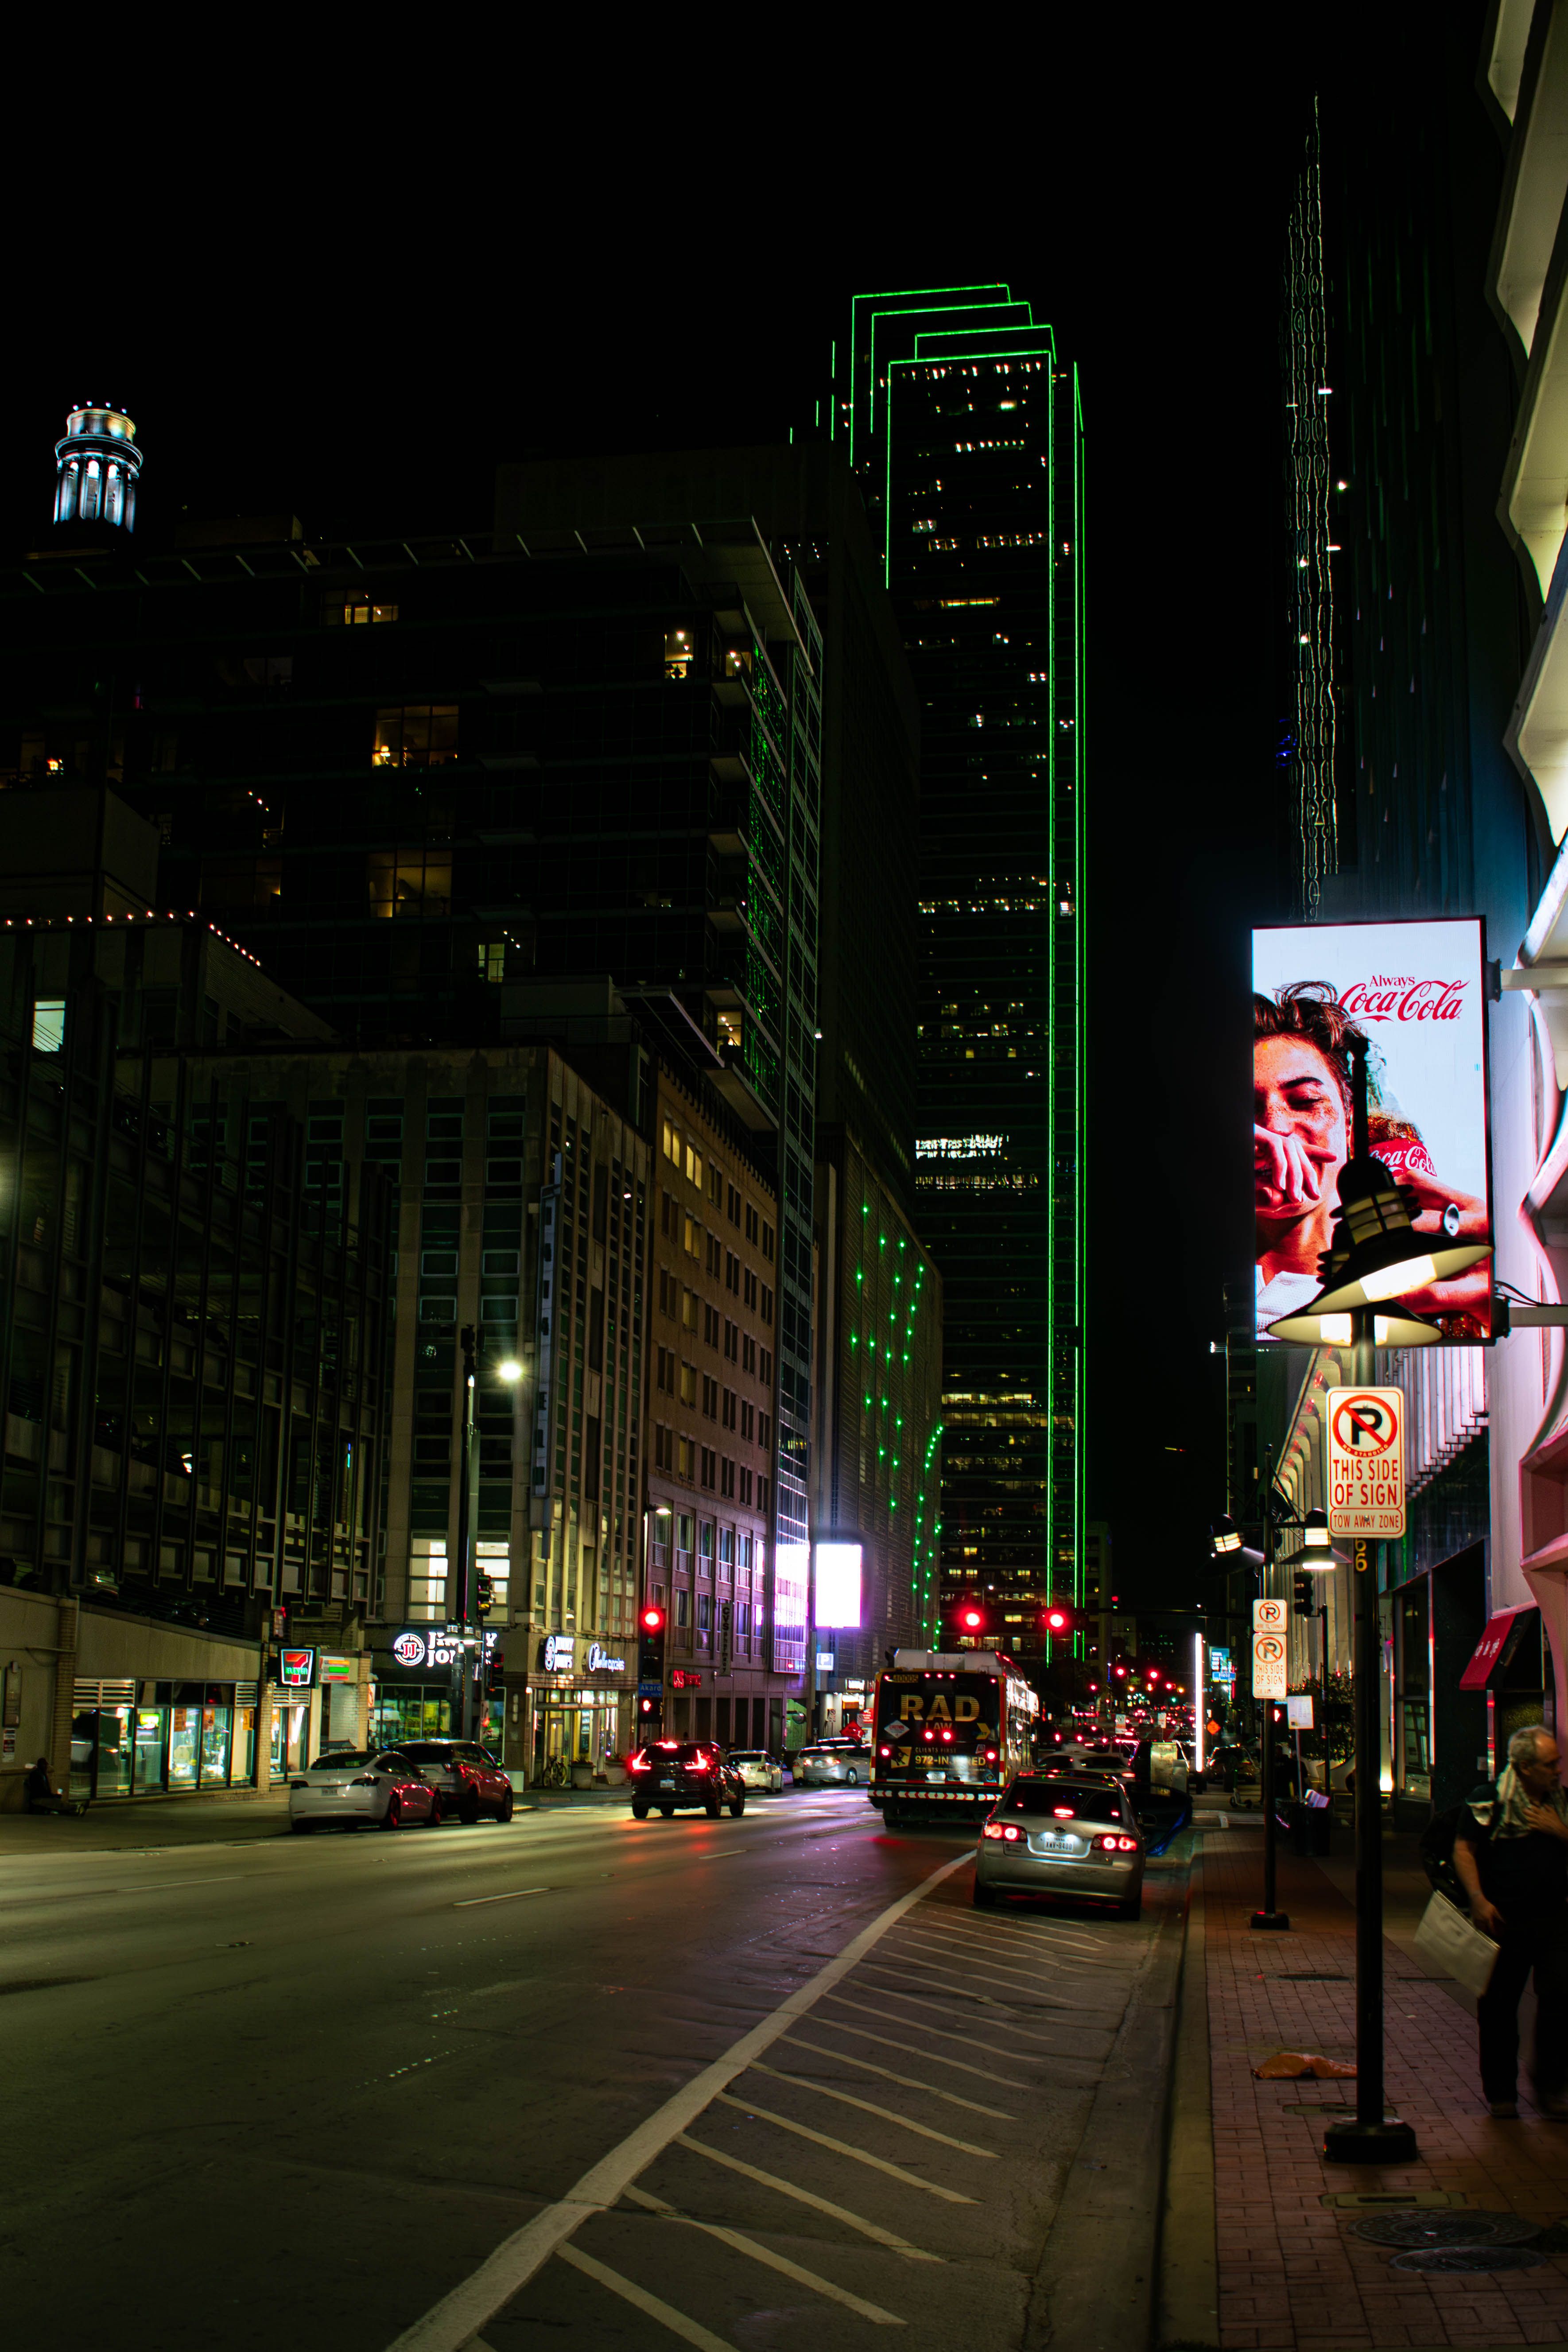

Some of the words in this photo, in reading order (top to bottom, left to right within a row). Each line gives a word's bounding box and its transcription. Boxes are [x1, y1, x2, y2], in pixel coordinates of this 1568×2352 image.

[1370, 975, 1415, 988] Always
[1338, 980, 1471, 1022] Coca-Cola
[1369, 1145, 1437, 1176] ca-Cola
[1343, 1444, 1351, 1452] NO
[1354, 1444, 1389, 1456] STANDING
[1333, 1459, 1362, 1480] THIS
[1369, 1459, 1398, 1480] SIDE
[1335, 1484, 1353, 1505] OF
[1361, 1484, 1397, 1505] SIGN
[1334, 1515, 1350, 1528] TOW
[1354, 1515, 1375, 1528] AWAY
[1379, 1515, 1399, 1528] ZONE
[402, 1642, 417, 1658] JJ
[1256, 1664, 1268, 1674] THIS
[1270, 1664, 1283, 1674] SIDE
[1256, 1675, 1265, 1684] OF
[1267, 1674, 1283, 1684] SIGN
[900, 1694, 980, 1722] RAD
